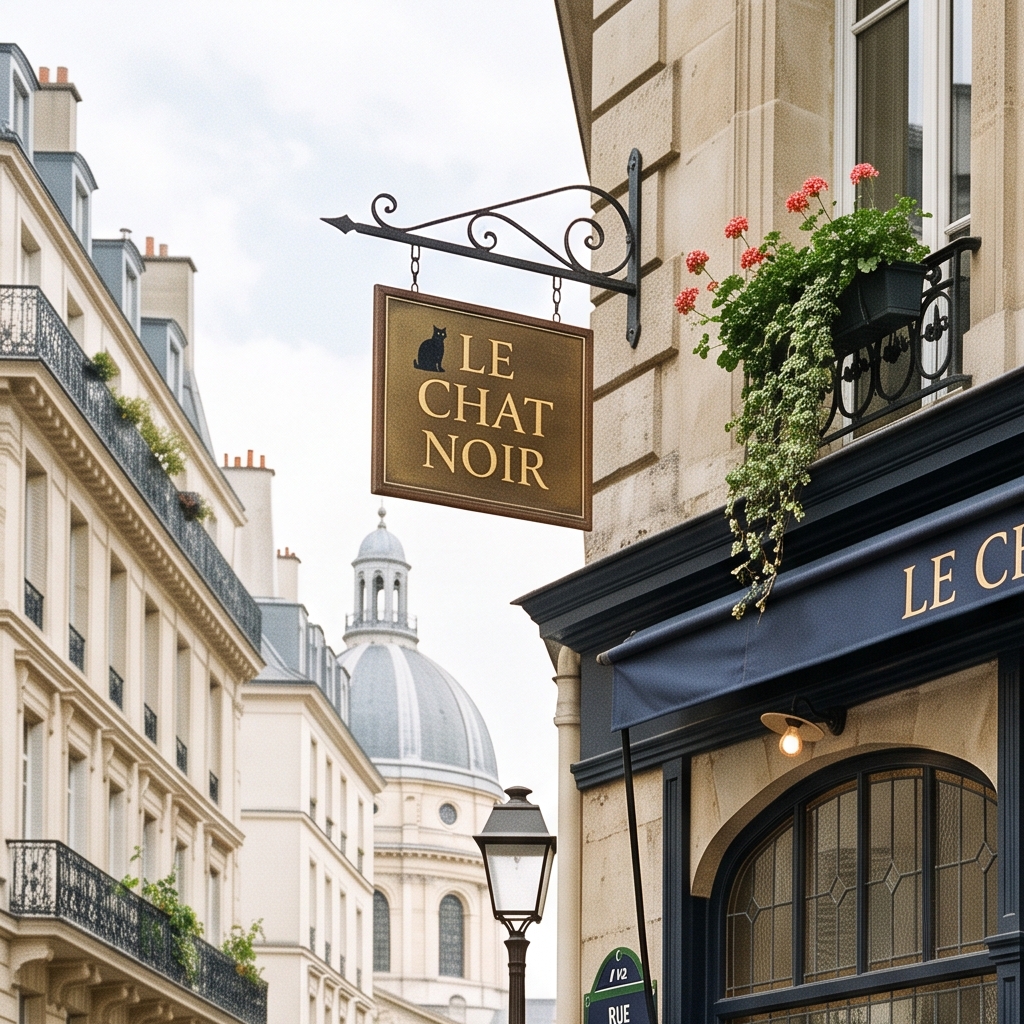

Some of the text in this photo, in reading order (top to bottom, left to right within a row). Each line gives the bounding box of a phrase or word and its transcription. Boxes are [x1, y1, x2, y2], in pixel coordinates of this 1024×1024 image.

[459, 333, 514, 380] LE
[418, 378, 554, 438] CHAT
[421, 429, 549, 490] NOIR
[901, 550, 956, 620] LE
